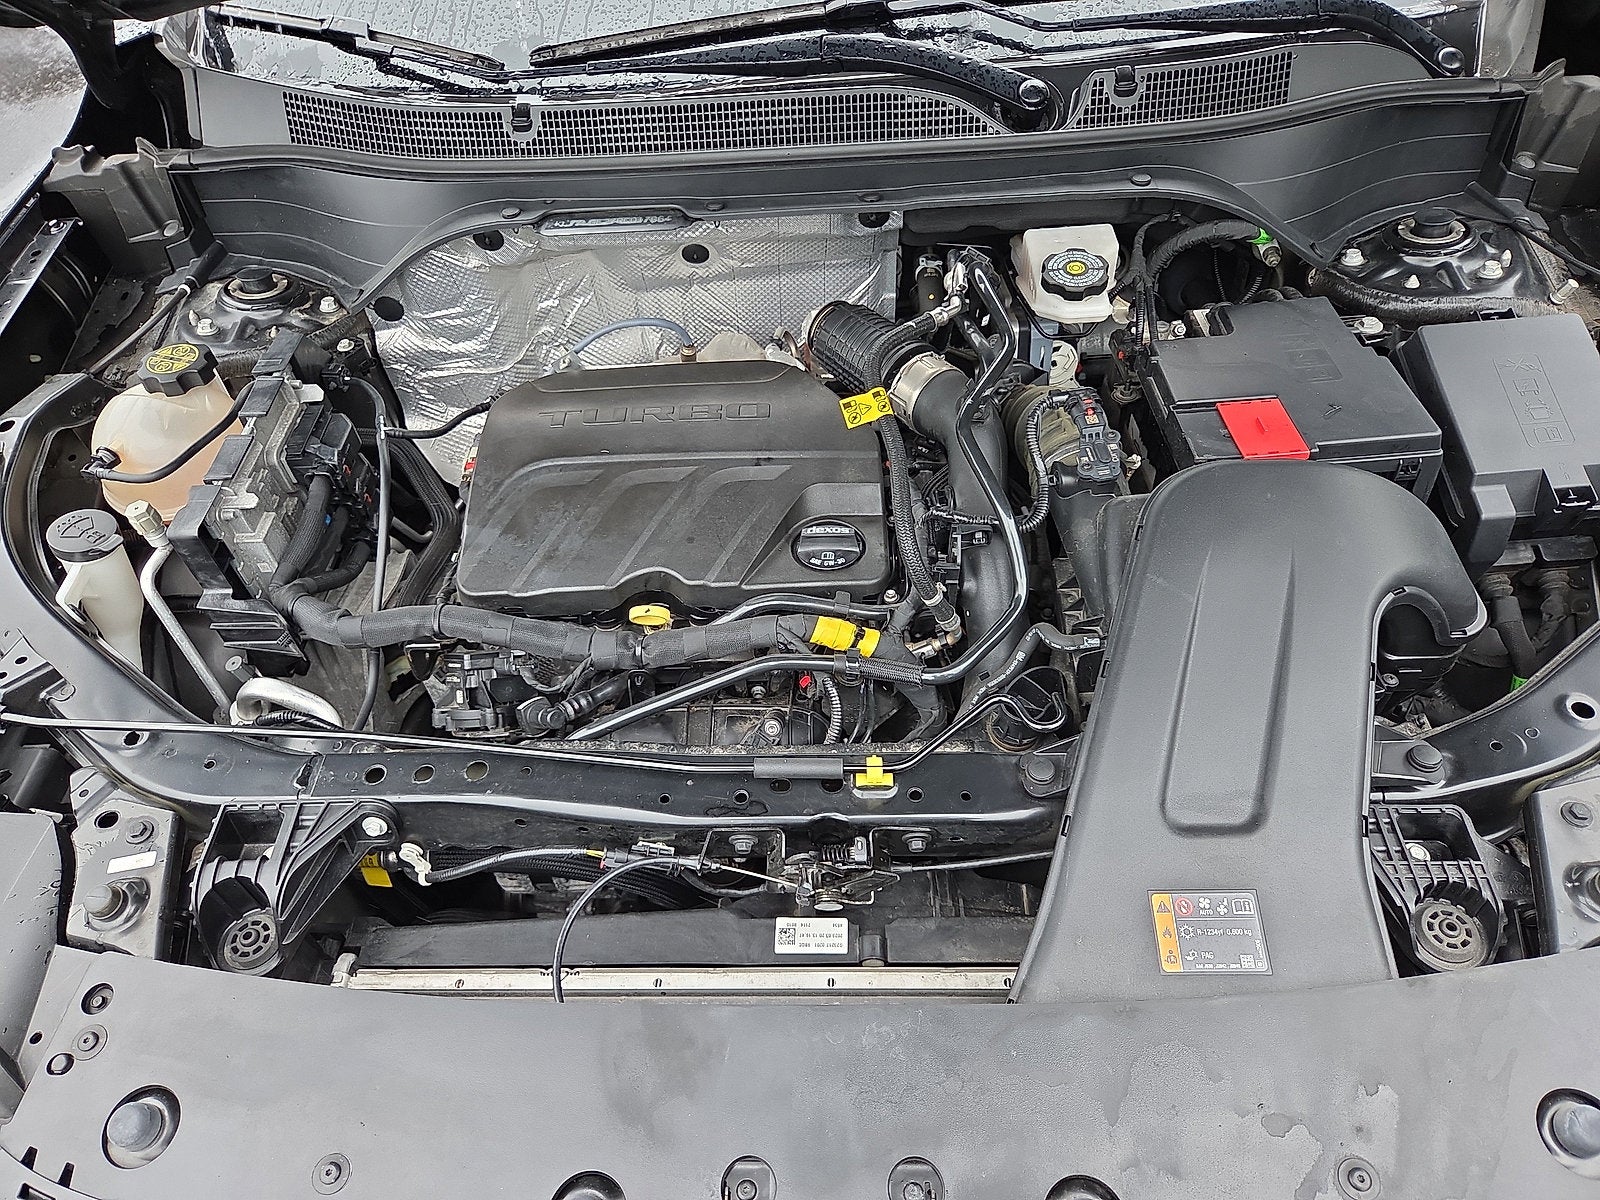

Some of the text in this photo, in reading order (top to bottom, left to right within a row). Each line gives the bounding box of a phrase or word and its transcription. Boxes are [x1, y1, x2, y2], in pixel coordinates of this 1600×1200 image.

[538, 403, 771, 428] TURBO
[806, 526, 851, 534] dexos
[1201, 951, 1214, 960] PAG
